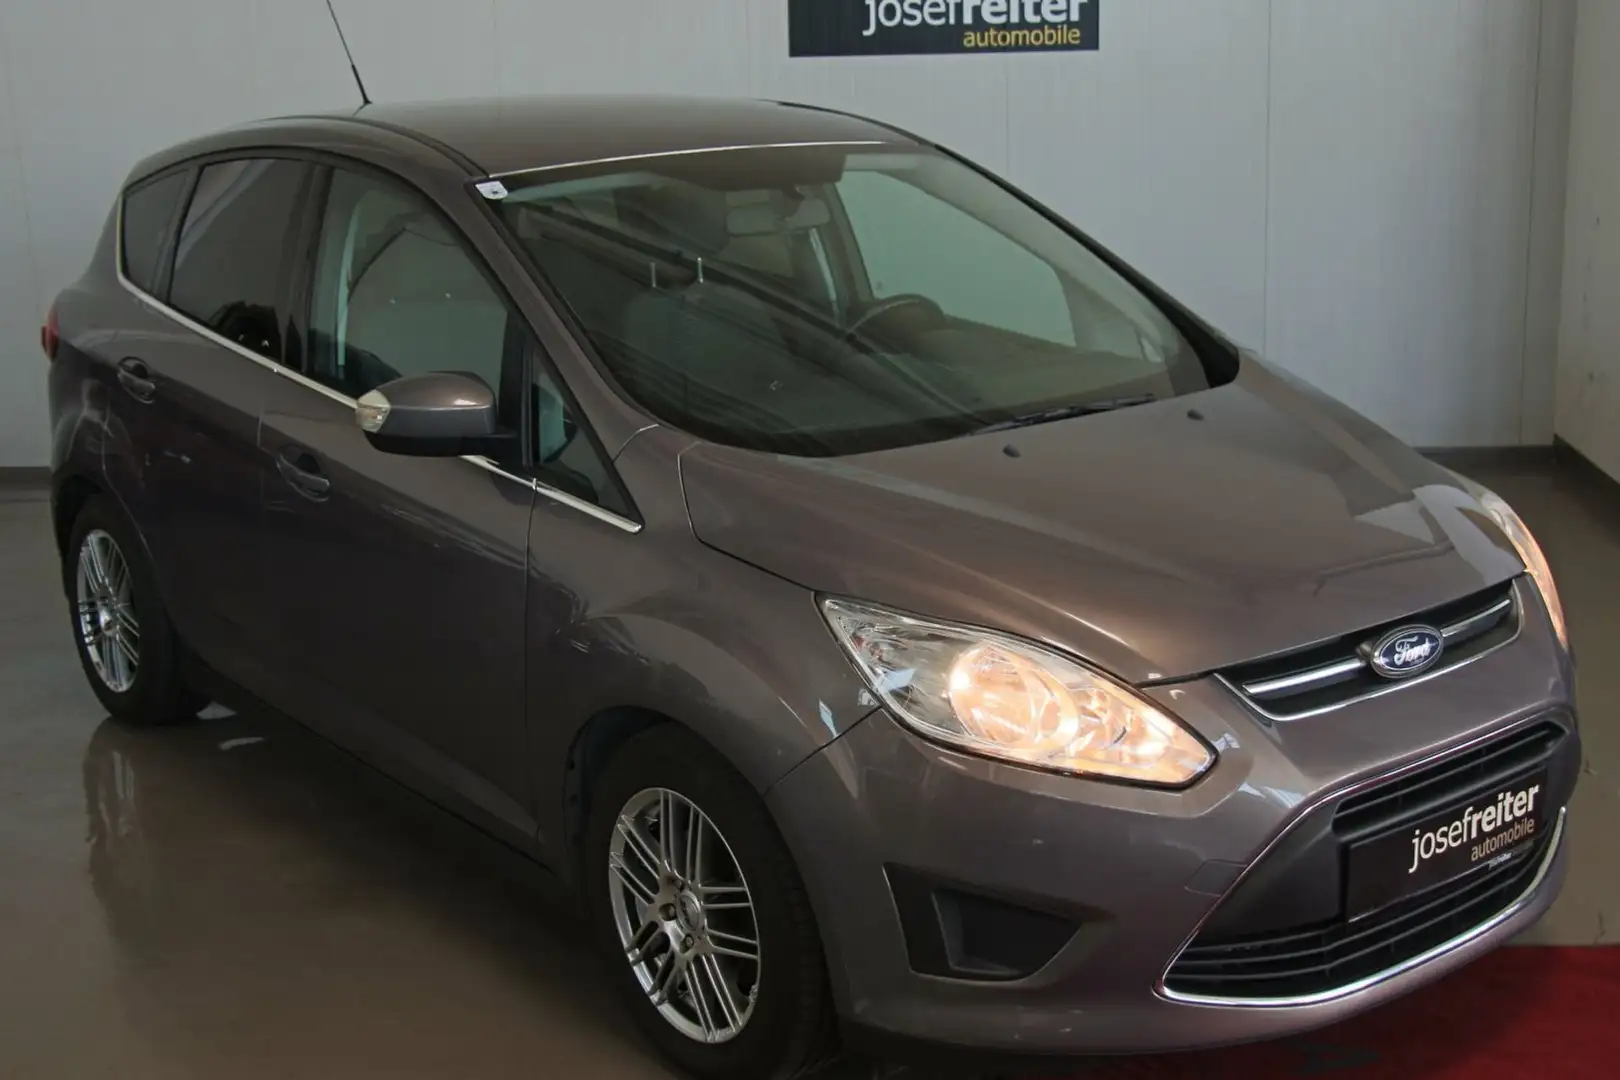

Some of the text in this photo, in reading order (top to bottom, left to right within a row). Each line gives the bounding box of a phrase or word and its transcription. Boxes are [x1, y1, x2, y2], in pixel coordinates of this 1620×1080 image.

[962, 24, 1081, 48] automobile
[1393, 635, 1436, 666] Ford
[1408, 784, 1540, 874] josefreiter
[1471, 817, 1535, 862] automobile
